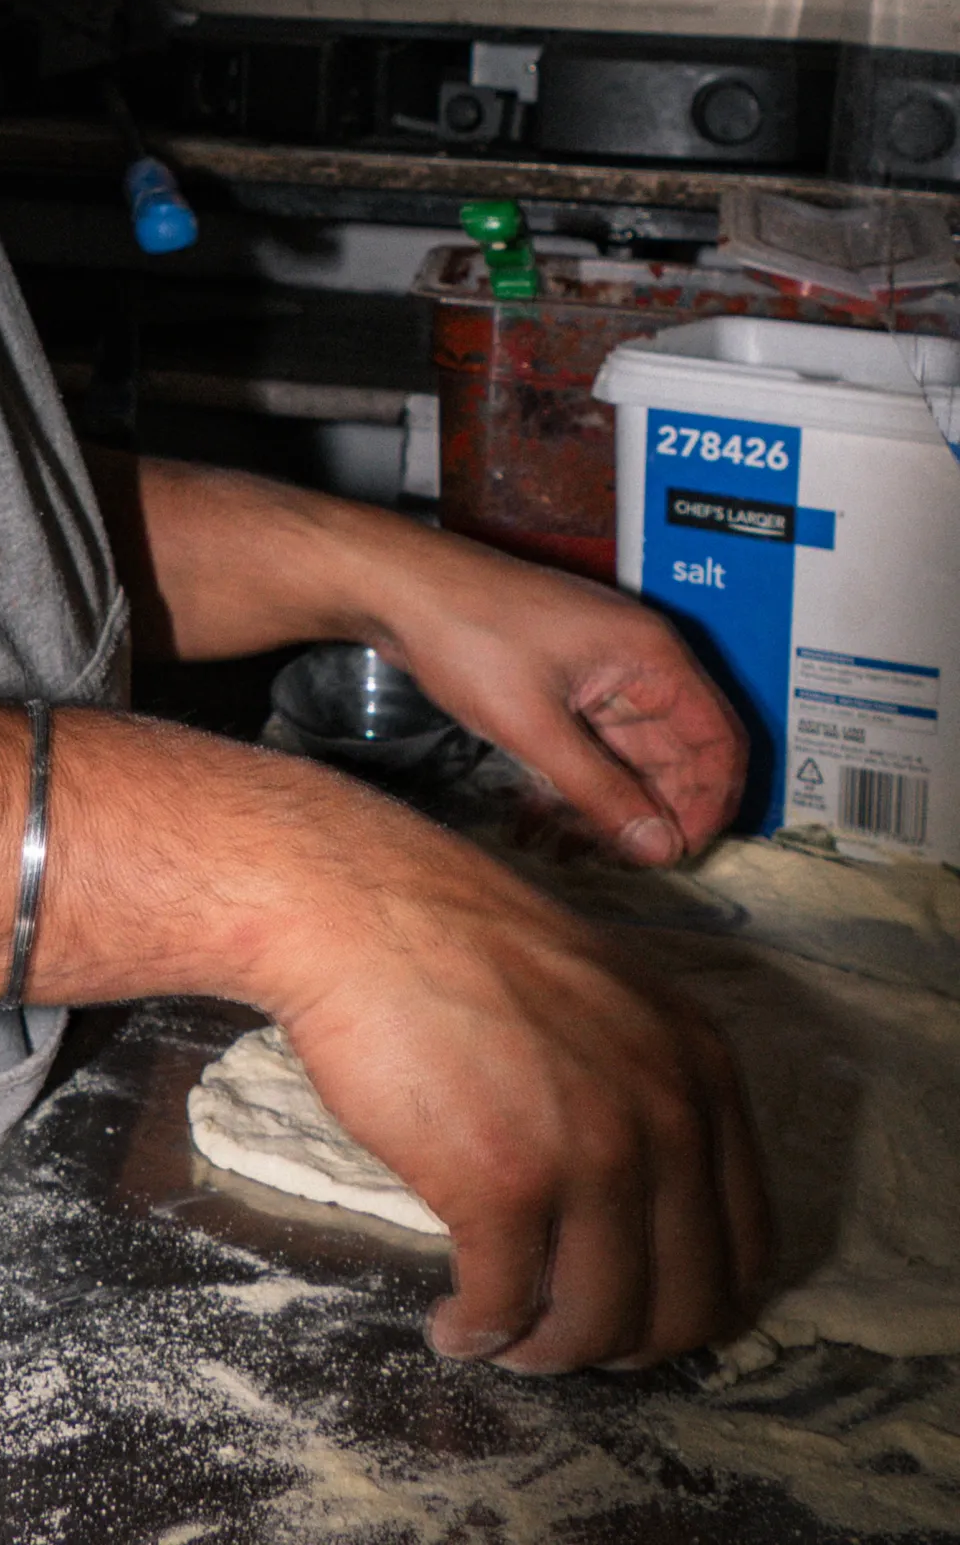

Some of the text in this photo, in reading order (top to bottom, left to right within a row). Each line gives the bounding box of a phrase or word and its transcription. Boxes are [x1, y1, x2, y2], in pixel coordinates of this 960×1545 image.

[656, 425, 789, 471] 278426
[675, 499, 787, 530] CHEF'S LARDER
[672, 556, 726, 589] salt
